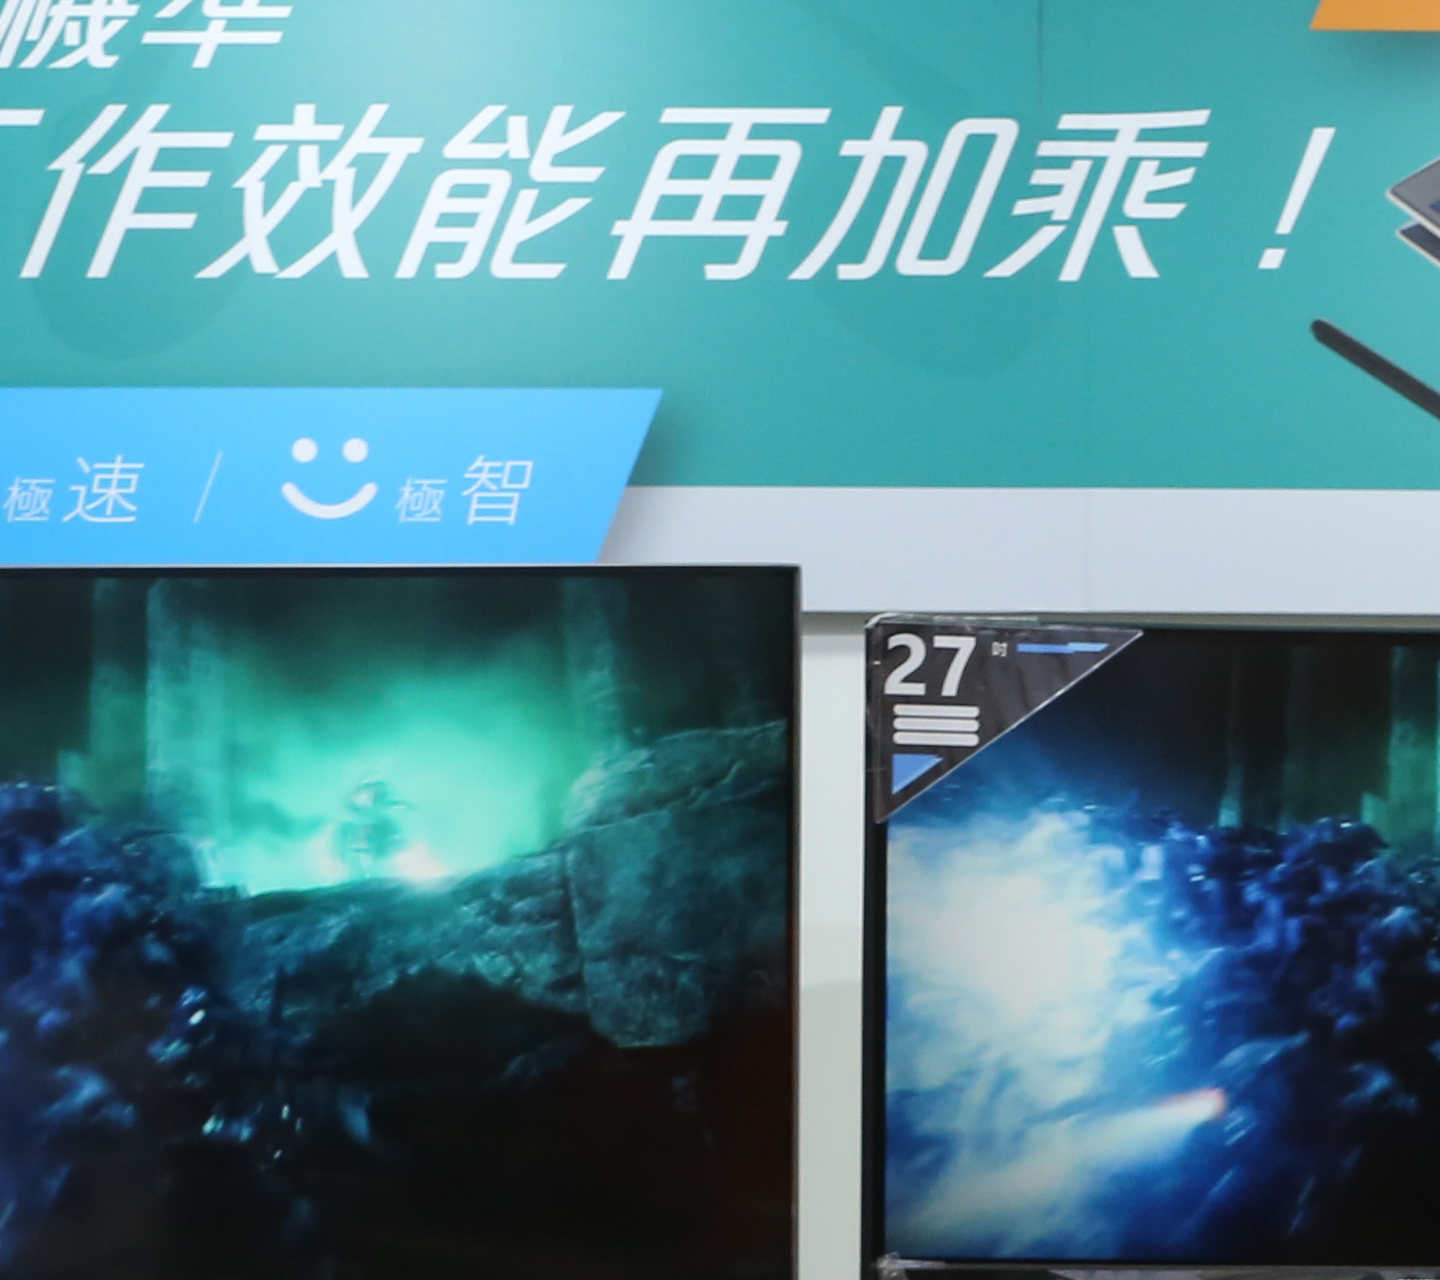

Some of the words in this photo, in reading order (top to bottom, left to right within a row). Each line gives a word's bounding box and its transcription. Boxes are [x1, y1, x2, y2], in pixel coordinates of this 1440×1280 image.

[1, 455, 146, 526] 極速
[394, 452, 536, 526] 極智
[883, 632, 978, 697] 27
